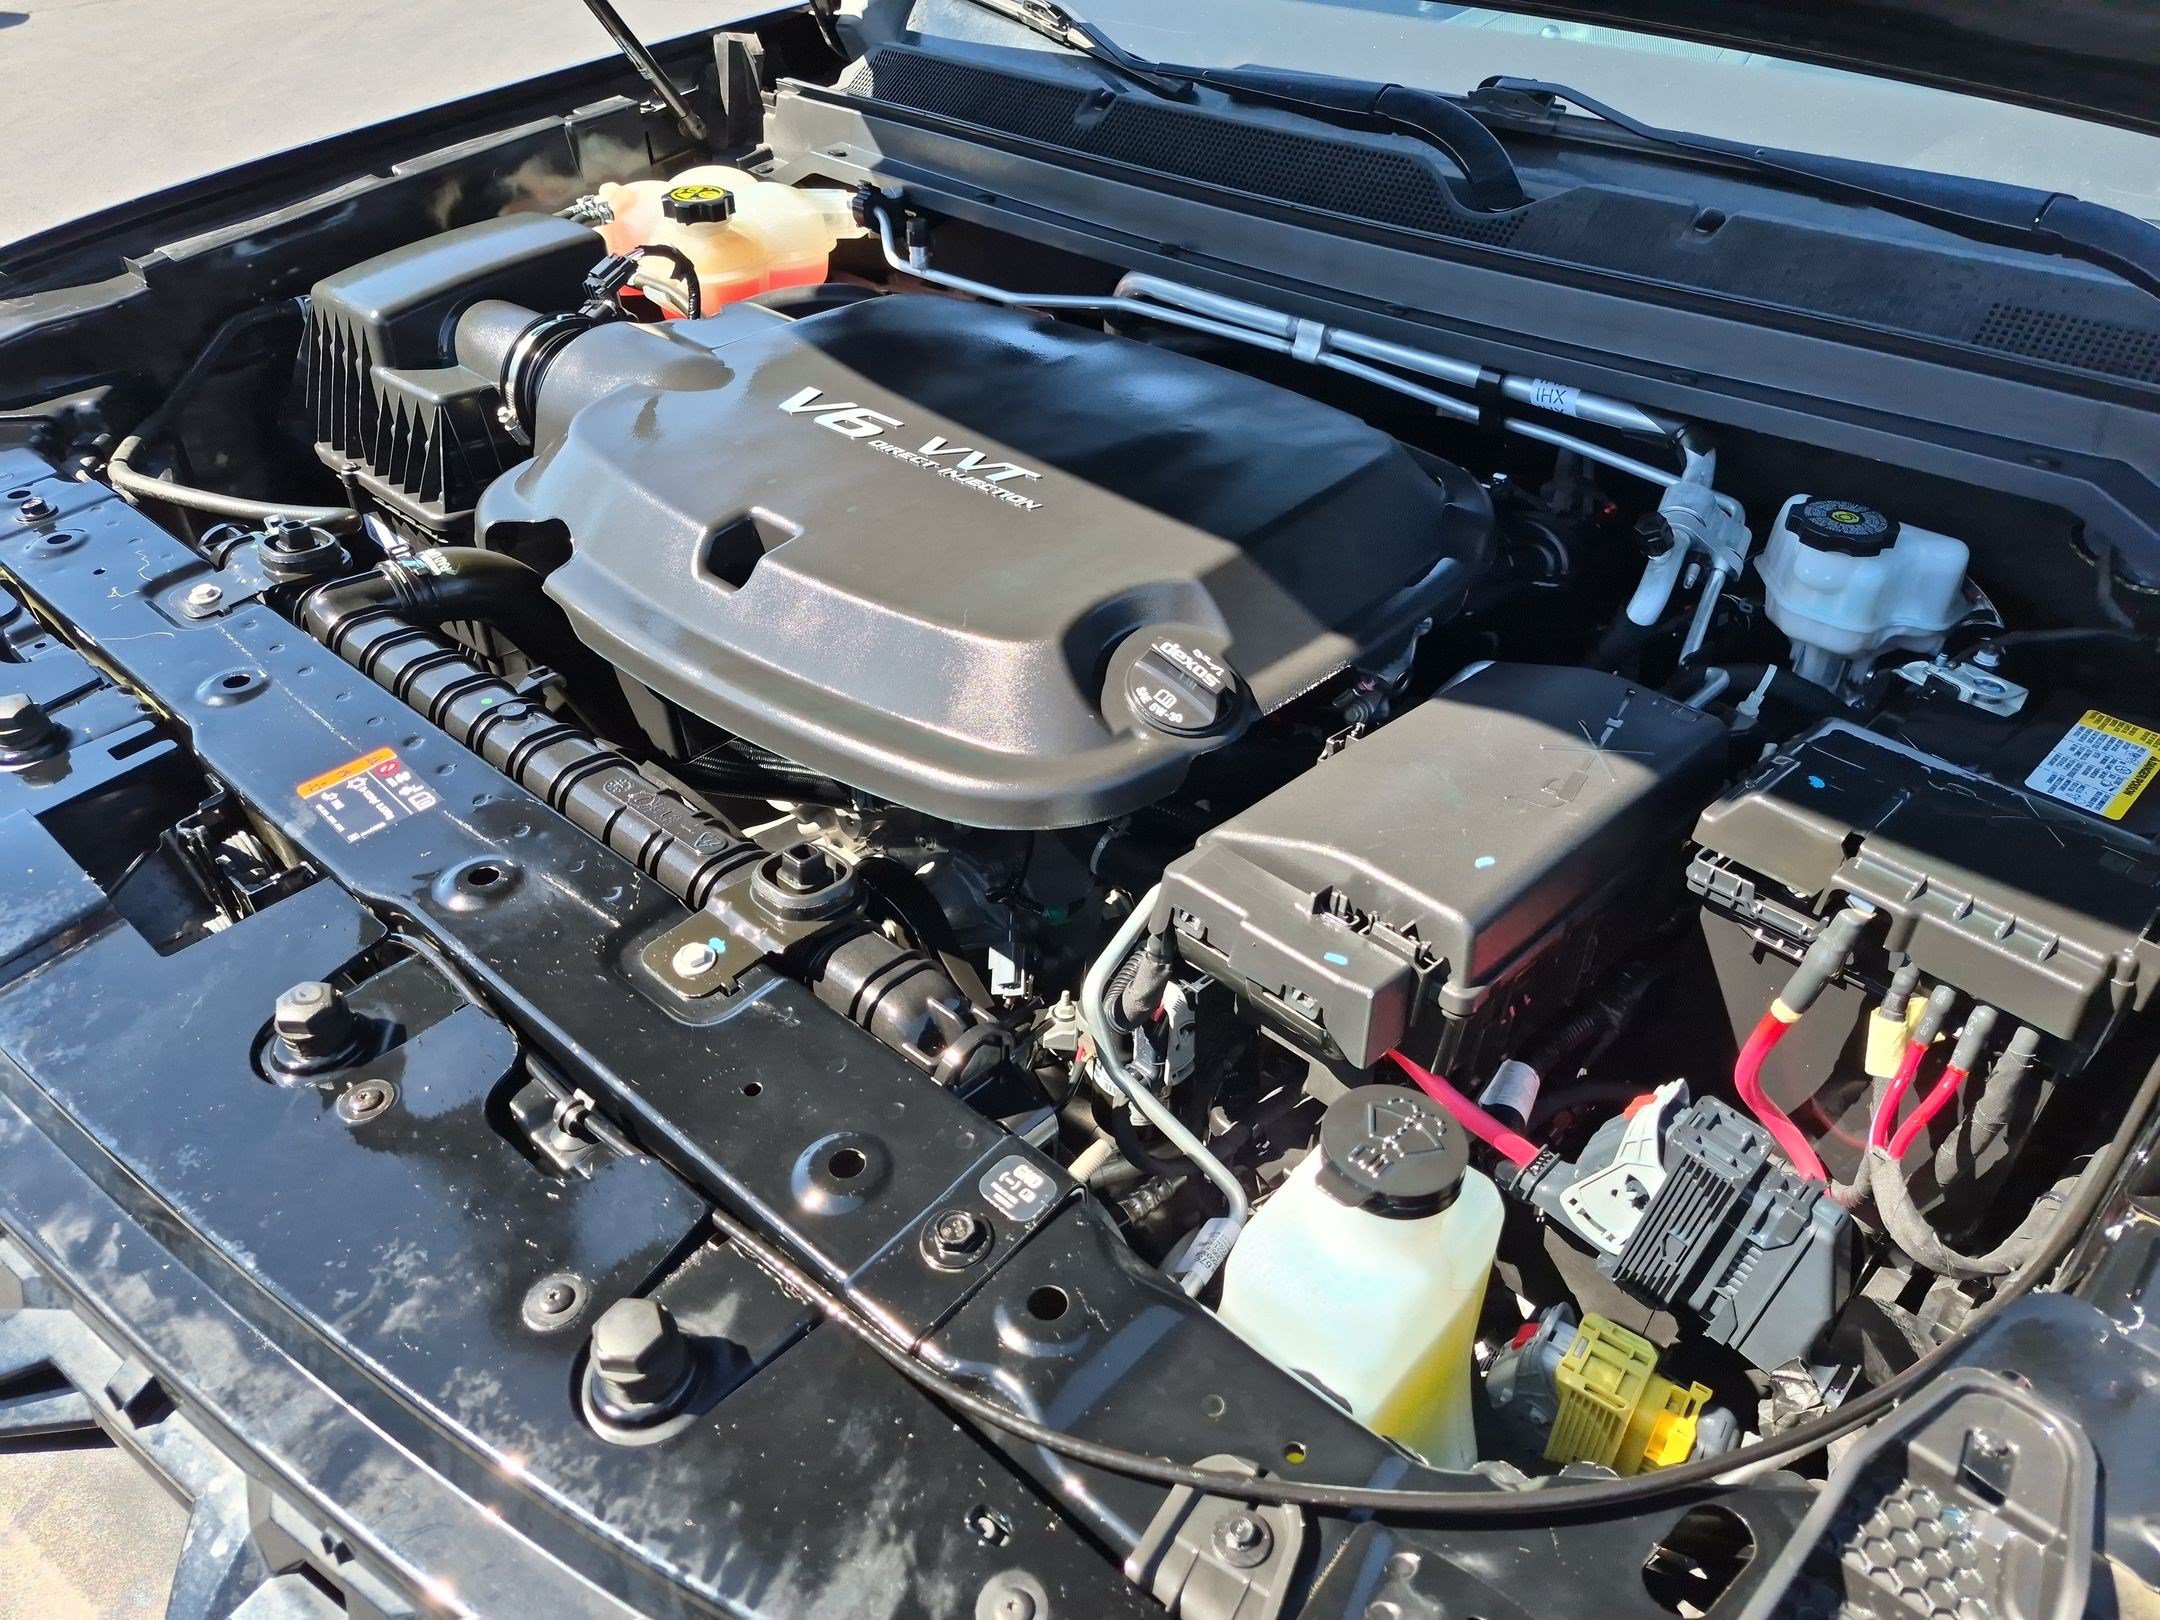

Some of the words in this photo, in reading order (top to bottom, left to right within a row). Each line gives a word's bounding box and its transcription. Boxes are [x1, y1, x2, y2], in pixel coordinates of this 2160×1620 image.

[1536, 387, 1567, 405] IHX
[778, 386, 905, 440] V6
[918, 436, 1043, 484] VVT
[868, 439, 941, 469] DIRECT
[936, 467, 1044, 511] INJECTION
[1159, 640, 1221, 688] dexos
[1148, 702, 1184, 723] 5W-30
